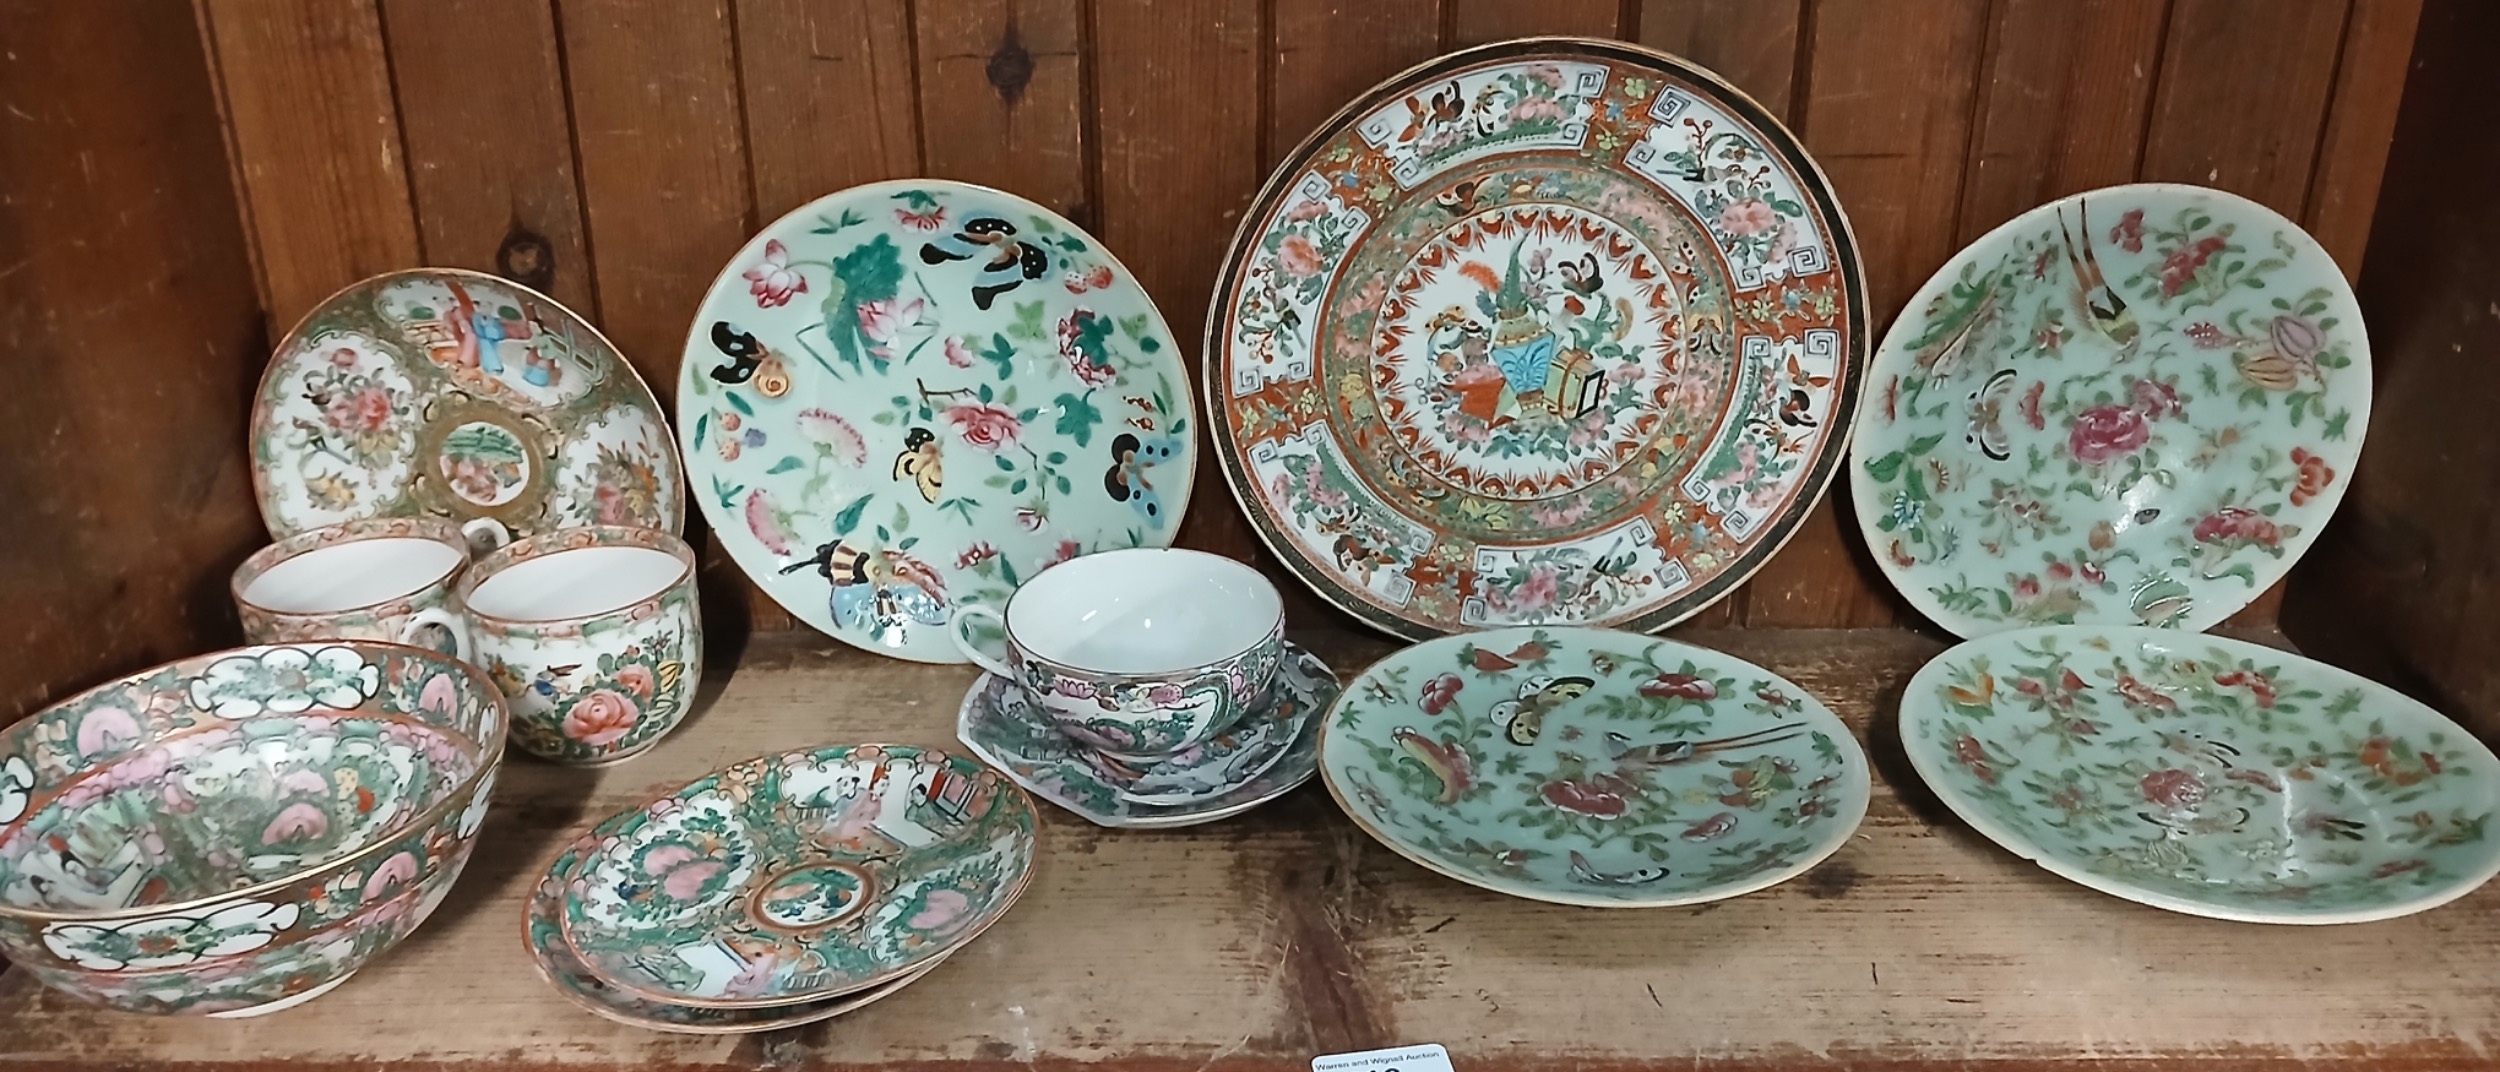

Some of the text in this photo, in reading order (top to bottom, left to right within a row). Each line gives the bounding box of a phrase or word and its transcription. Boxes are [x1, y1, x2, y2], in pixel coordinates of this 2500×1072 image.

[1315, 1062, 1349, 1071] Warren
[1351, 1058, 1368, 1066] and
[1406, 1052, 1439, 1061] Auction
